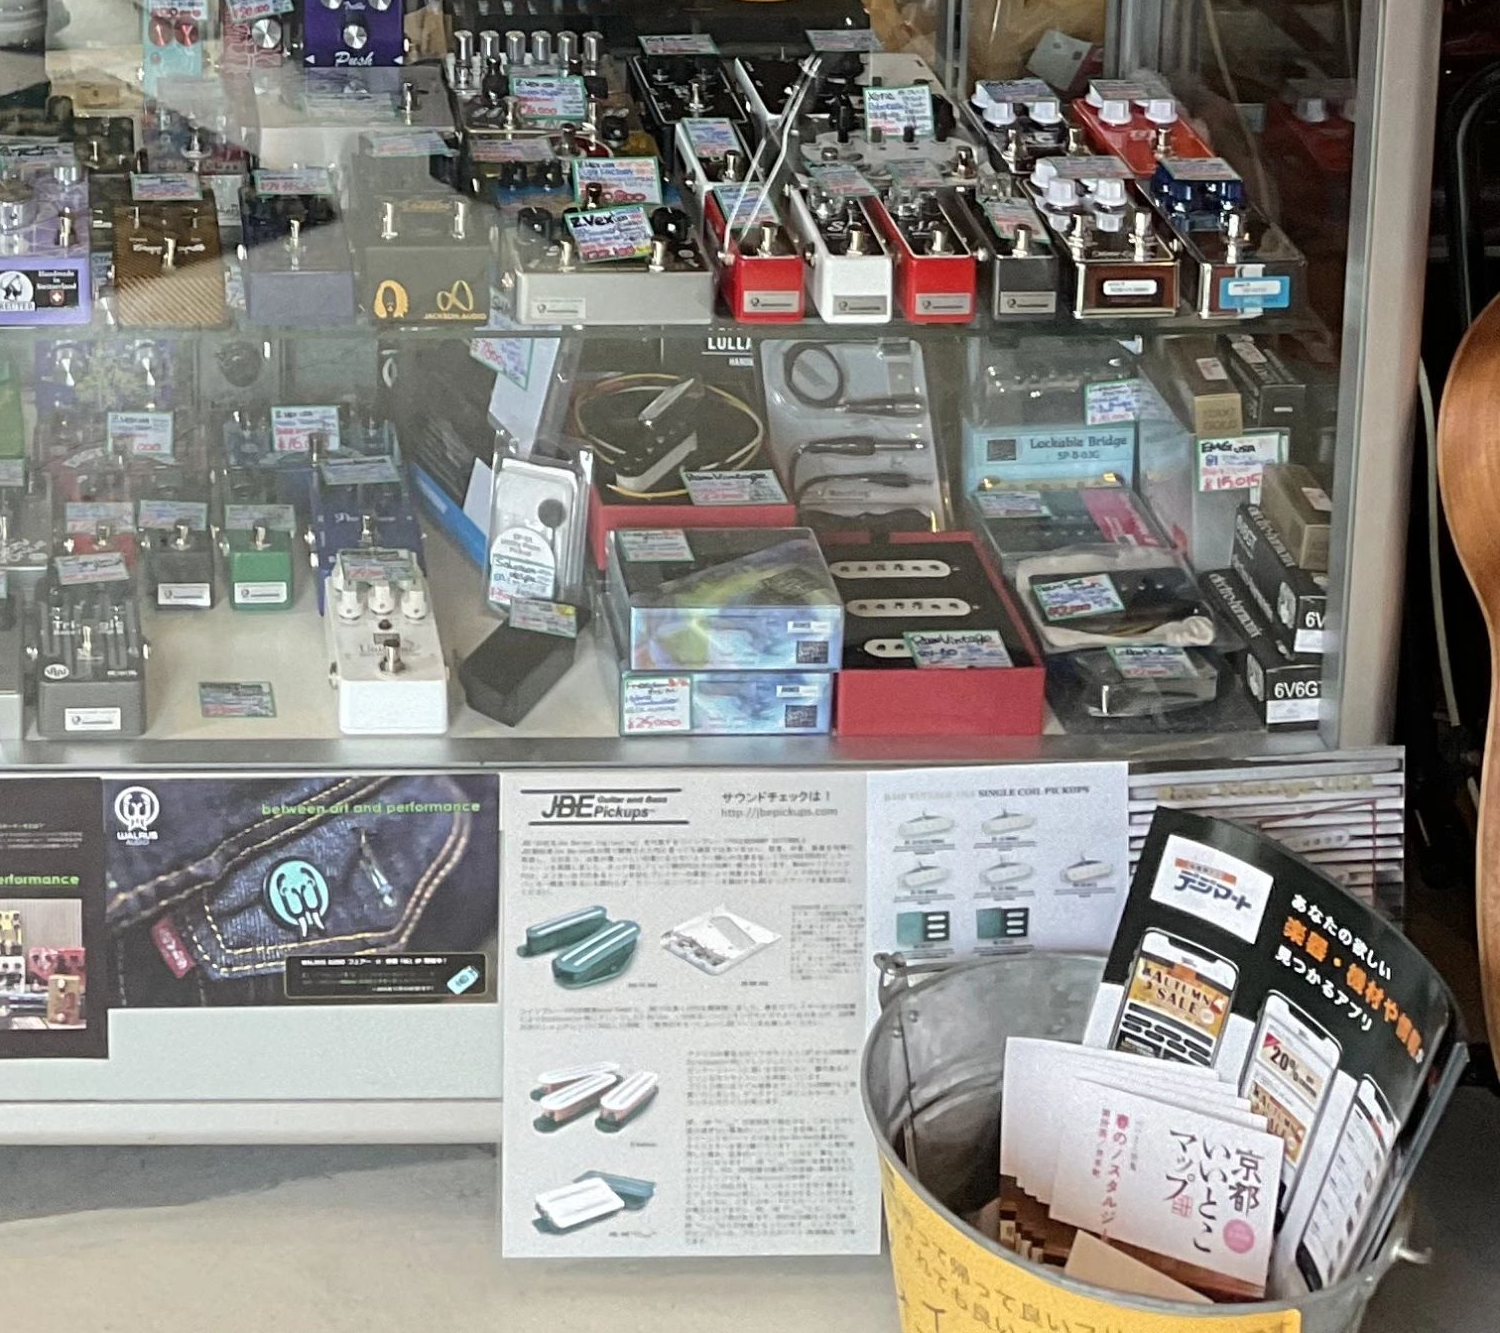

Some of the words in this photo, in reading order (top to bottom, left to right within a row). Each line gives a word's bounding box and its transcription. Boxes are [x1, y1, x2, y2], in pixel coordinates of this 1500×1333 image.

[335, 50, 374, 69] Push
[1274, 682, 1322, 699] 6V6G
[978, 789, 1016, 798] SINGLE
[261, 804, 328, 816] between
[332, 803, 350, 815] art
[353, 802, 383, 815] and
[386, 801, 481, 815] performance
[541, 794, 595, 819] JBE
[620, 795, 643, 804] and
[594, 804, 650, 822] Pickups
[116, 831, 158, 840] WALRUS
[1275, 944, 1374, 1031] 見つかるアプリ
[1156, 987, 1198, 1015] SALE
[1165, 1129, 1197, 1201] マップ
[1228, 1149, 1264, 1216] 京都
[1192, 1135, 1231, 1253] いいとこ
